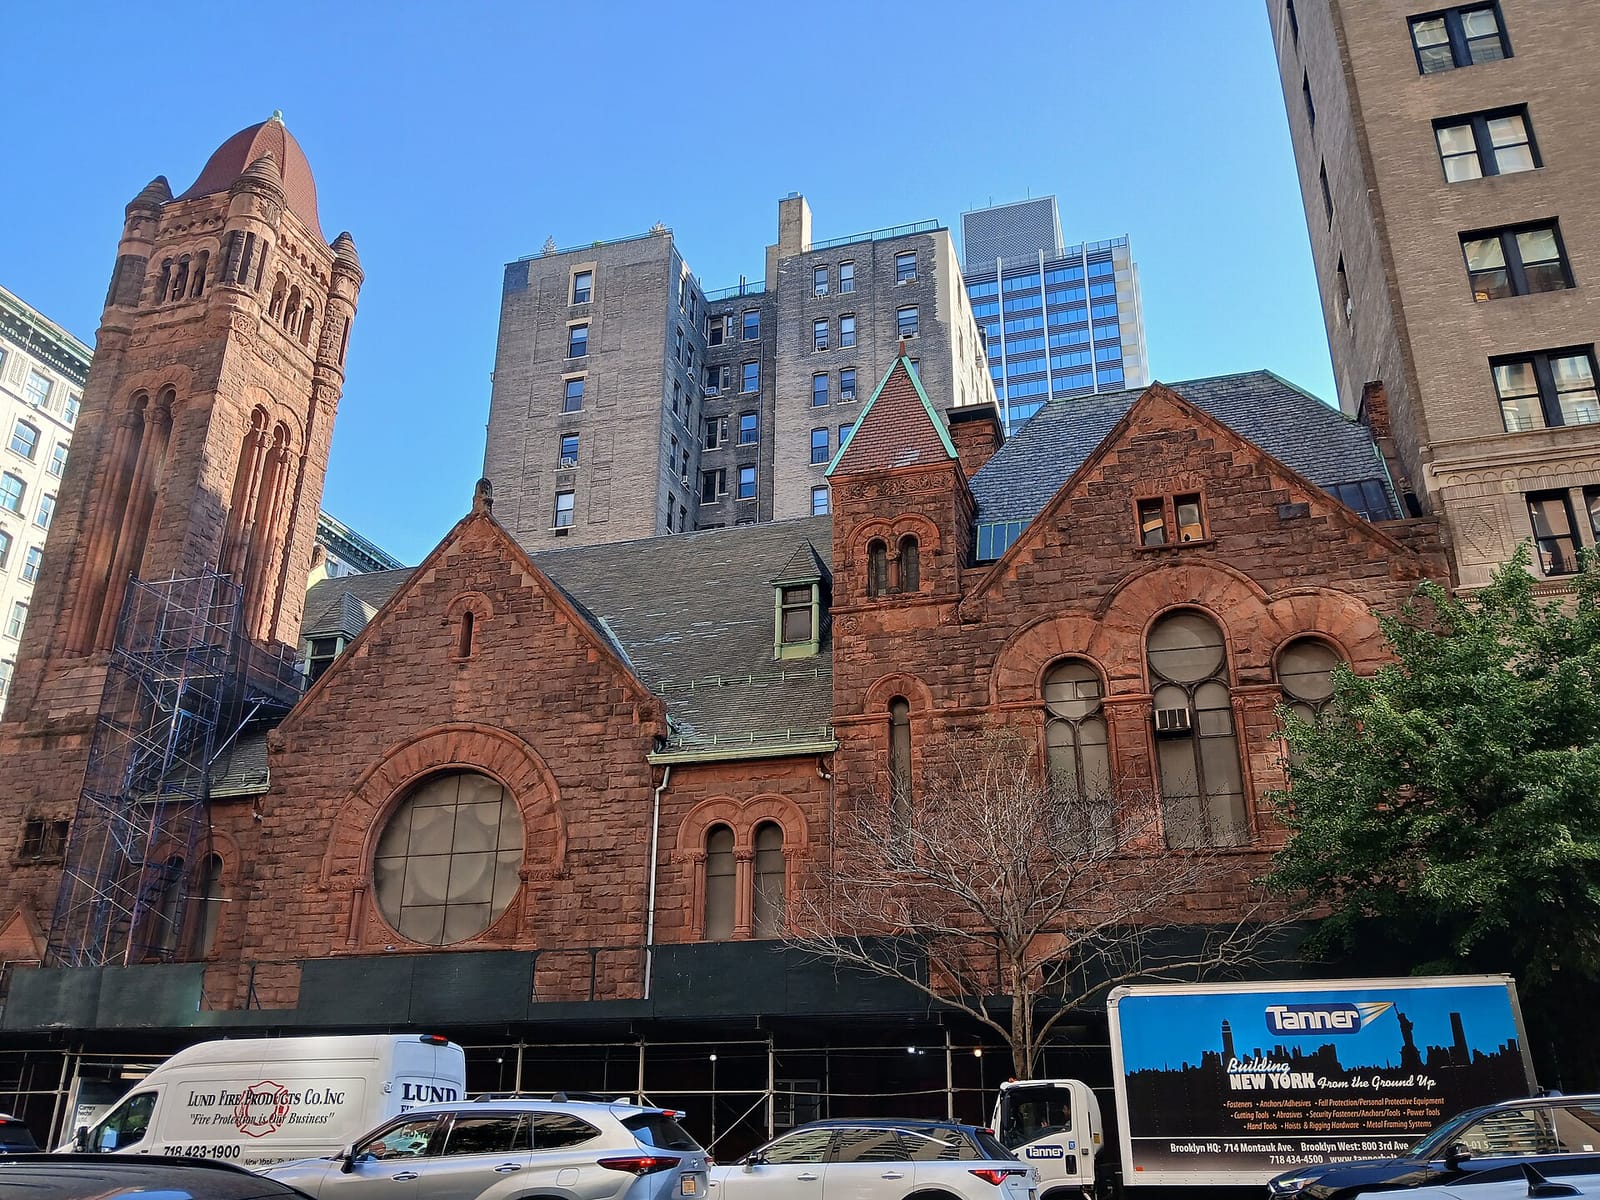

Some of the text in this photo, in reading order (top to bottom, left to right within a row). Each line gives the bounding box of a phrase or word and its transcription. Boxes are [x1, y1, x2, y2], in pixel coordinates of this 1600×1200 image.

[1265, 1006, 1358, 1029] Tanner
[1227, 1057, 1290, 1074] Building
[1230, 1073, 1436, 1090] NEW YORK From the Ground Up
[188, 1091, 216, 1106] LUND
[218, 1090, 242, 1105] FIRE
[402, 1083, 457, 1102] LUND
[1226, 1100, 1252, 1108] Fasteners
[1329, 1098, 1384, 1106] Protection/Personal
[1414, 1097, 1444, 1106] Equipment
[212, 1113, 254, 1125] Protection
[258, 1113, 266, 1124] is
[1234, 1112, 1254, 1120] Cutting
[1255, 1111, 1269, 1119] Tools
[1310, 1110, 1332, 1119] Security
[1407, 1108, 1424, 1116] Power
[1426, 1108, 1440, 1116] Tools
[1247, 1122, 1262, 1130] Hand
[1263, 1122, 1277, 1130] Tools
[1309, 1122, 1330, 1131] Rigging
[1384, 1120, 1408, 1129] Framing
[1409, 1120, 1432, 1129] Systems
[1026, 1145, 1062, 1157] Tanner
[1170, 1141, 1409, 1154] Brooklyn HQ: 714 Montauk Ave. Brooklyn West: 800 3rd Ave
[1270, 1155, 1284, 1164] 718
[1286, 1155, 1323, 1164] 434-4500
